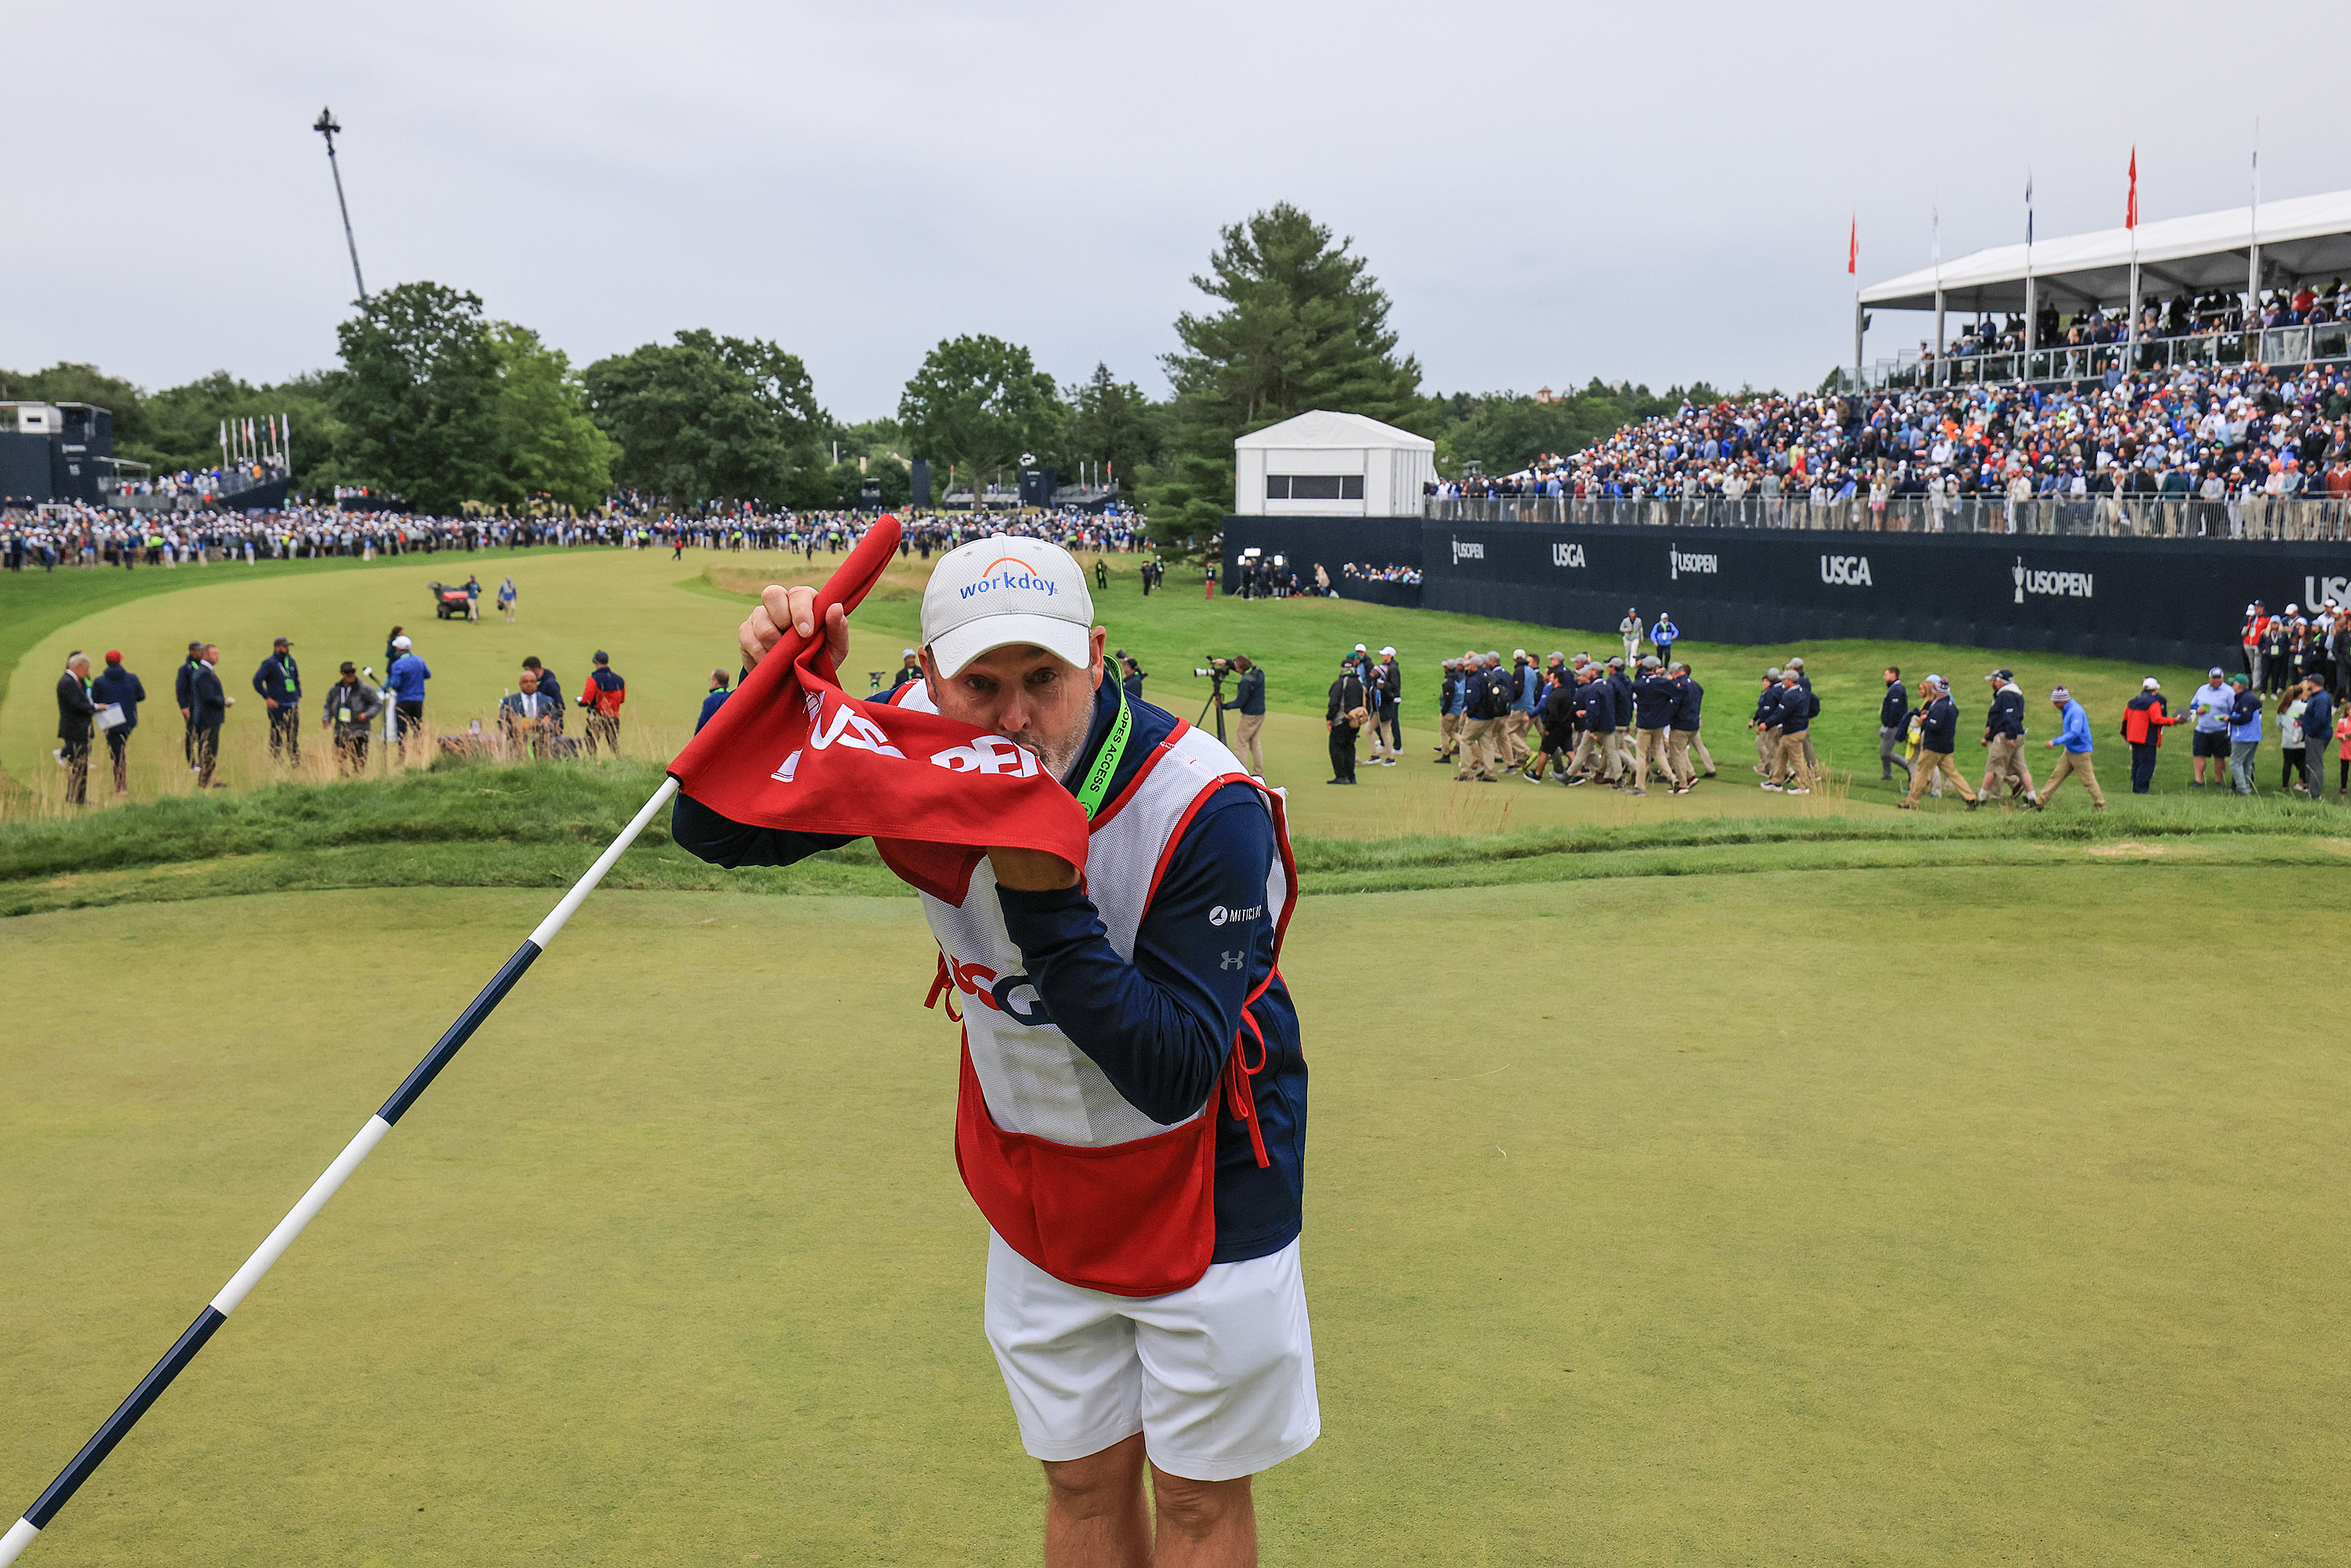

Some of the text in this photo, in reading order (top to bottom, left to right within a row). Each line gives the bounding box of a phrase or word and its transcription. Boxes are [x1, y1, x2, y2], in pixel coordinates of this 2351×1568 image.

[1552, 543, 1586, 568] USGA
[1820, 555, 1873, 586] USGA
[2305, 575, 2351, 614] US
[1089, 744, 1118, 793] ACCESS
[950, 953, 1058, 1027] USG
